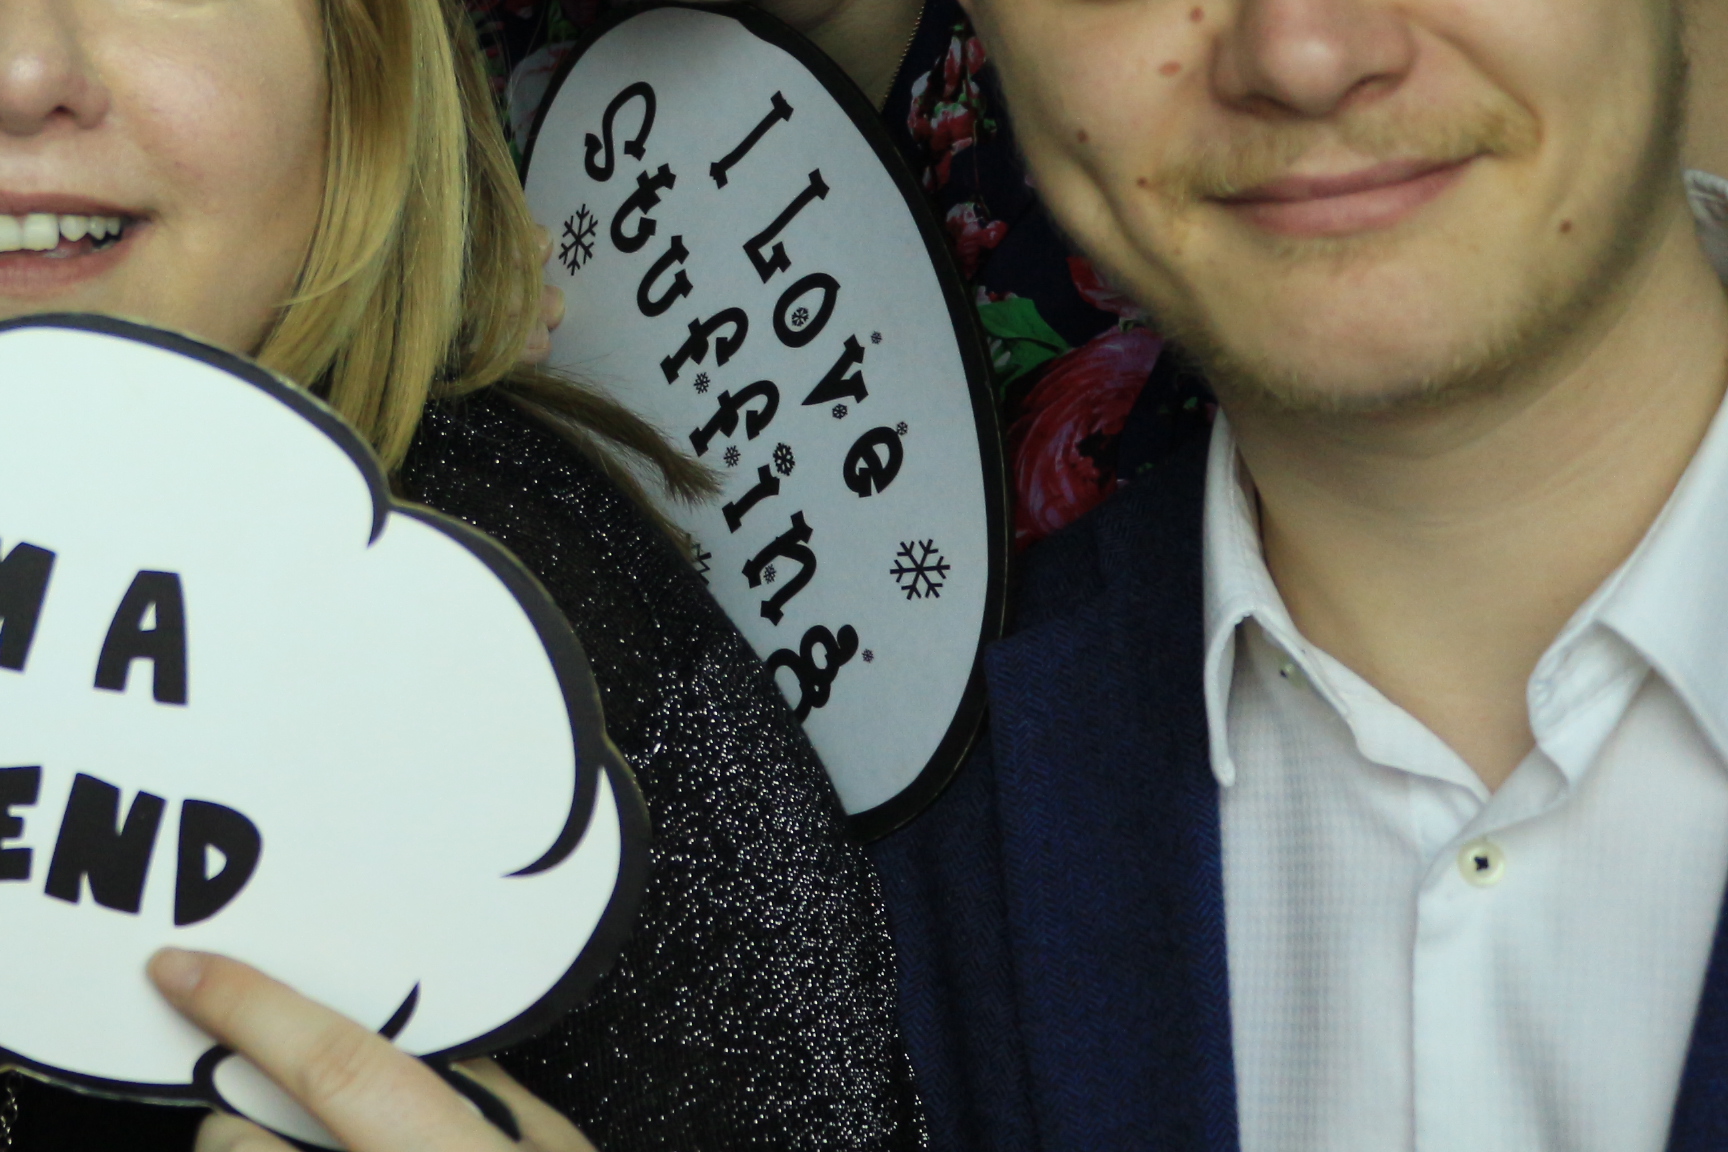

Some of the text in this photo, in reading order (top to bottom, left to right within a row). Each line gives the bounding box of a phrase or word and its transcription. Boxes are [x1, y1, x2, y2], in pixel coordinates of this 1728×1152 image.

[583, 80, 859, 723] Stuffing
[709, 90, 904, 498] I Love
[93, 570, 188, 706] A
